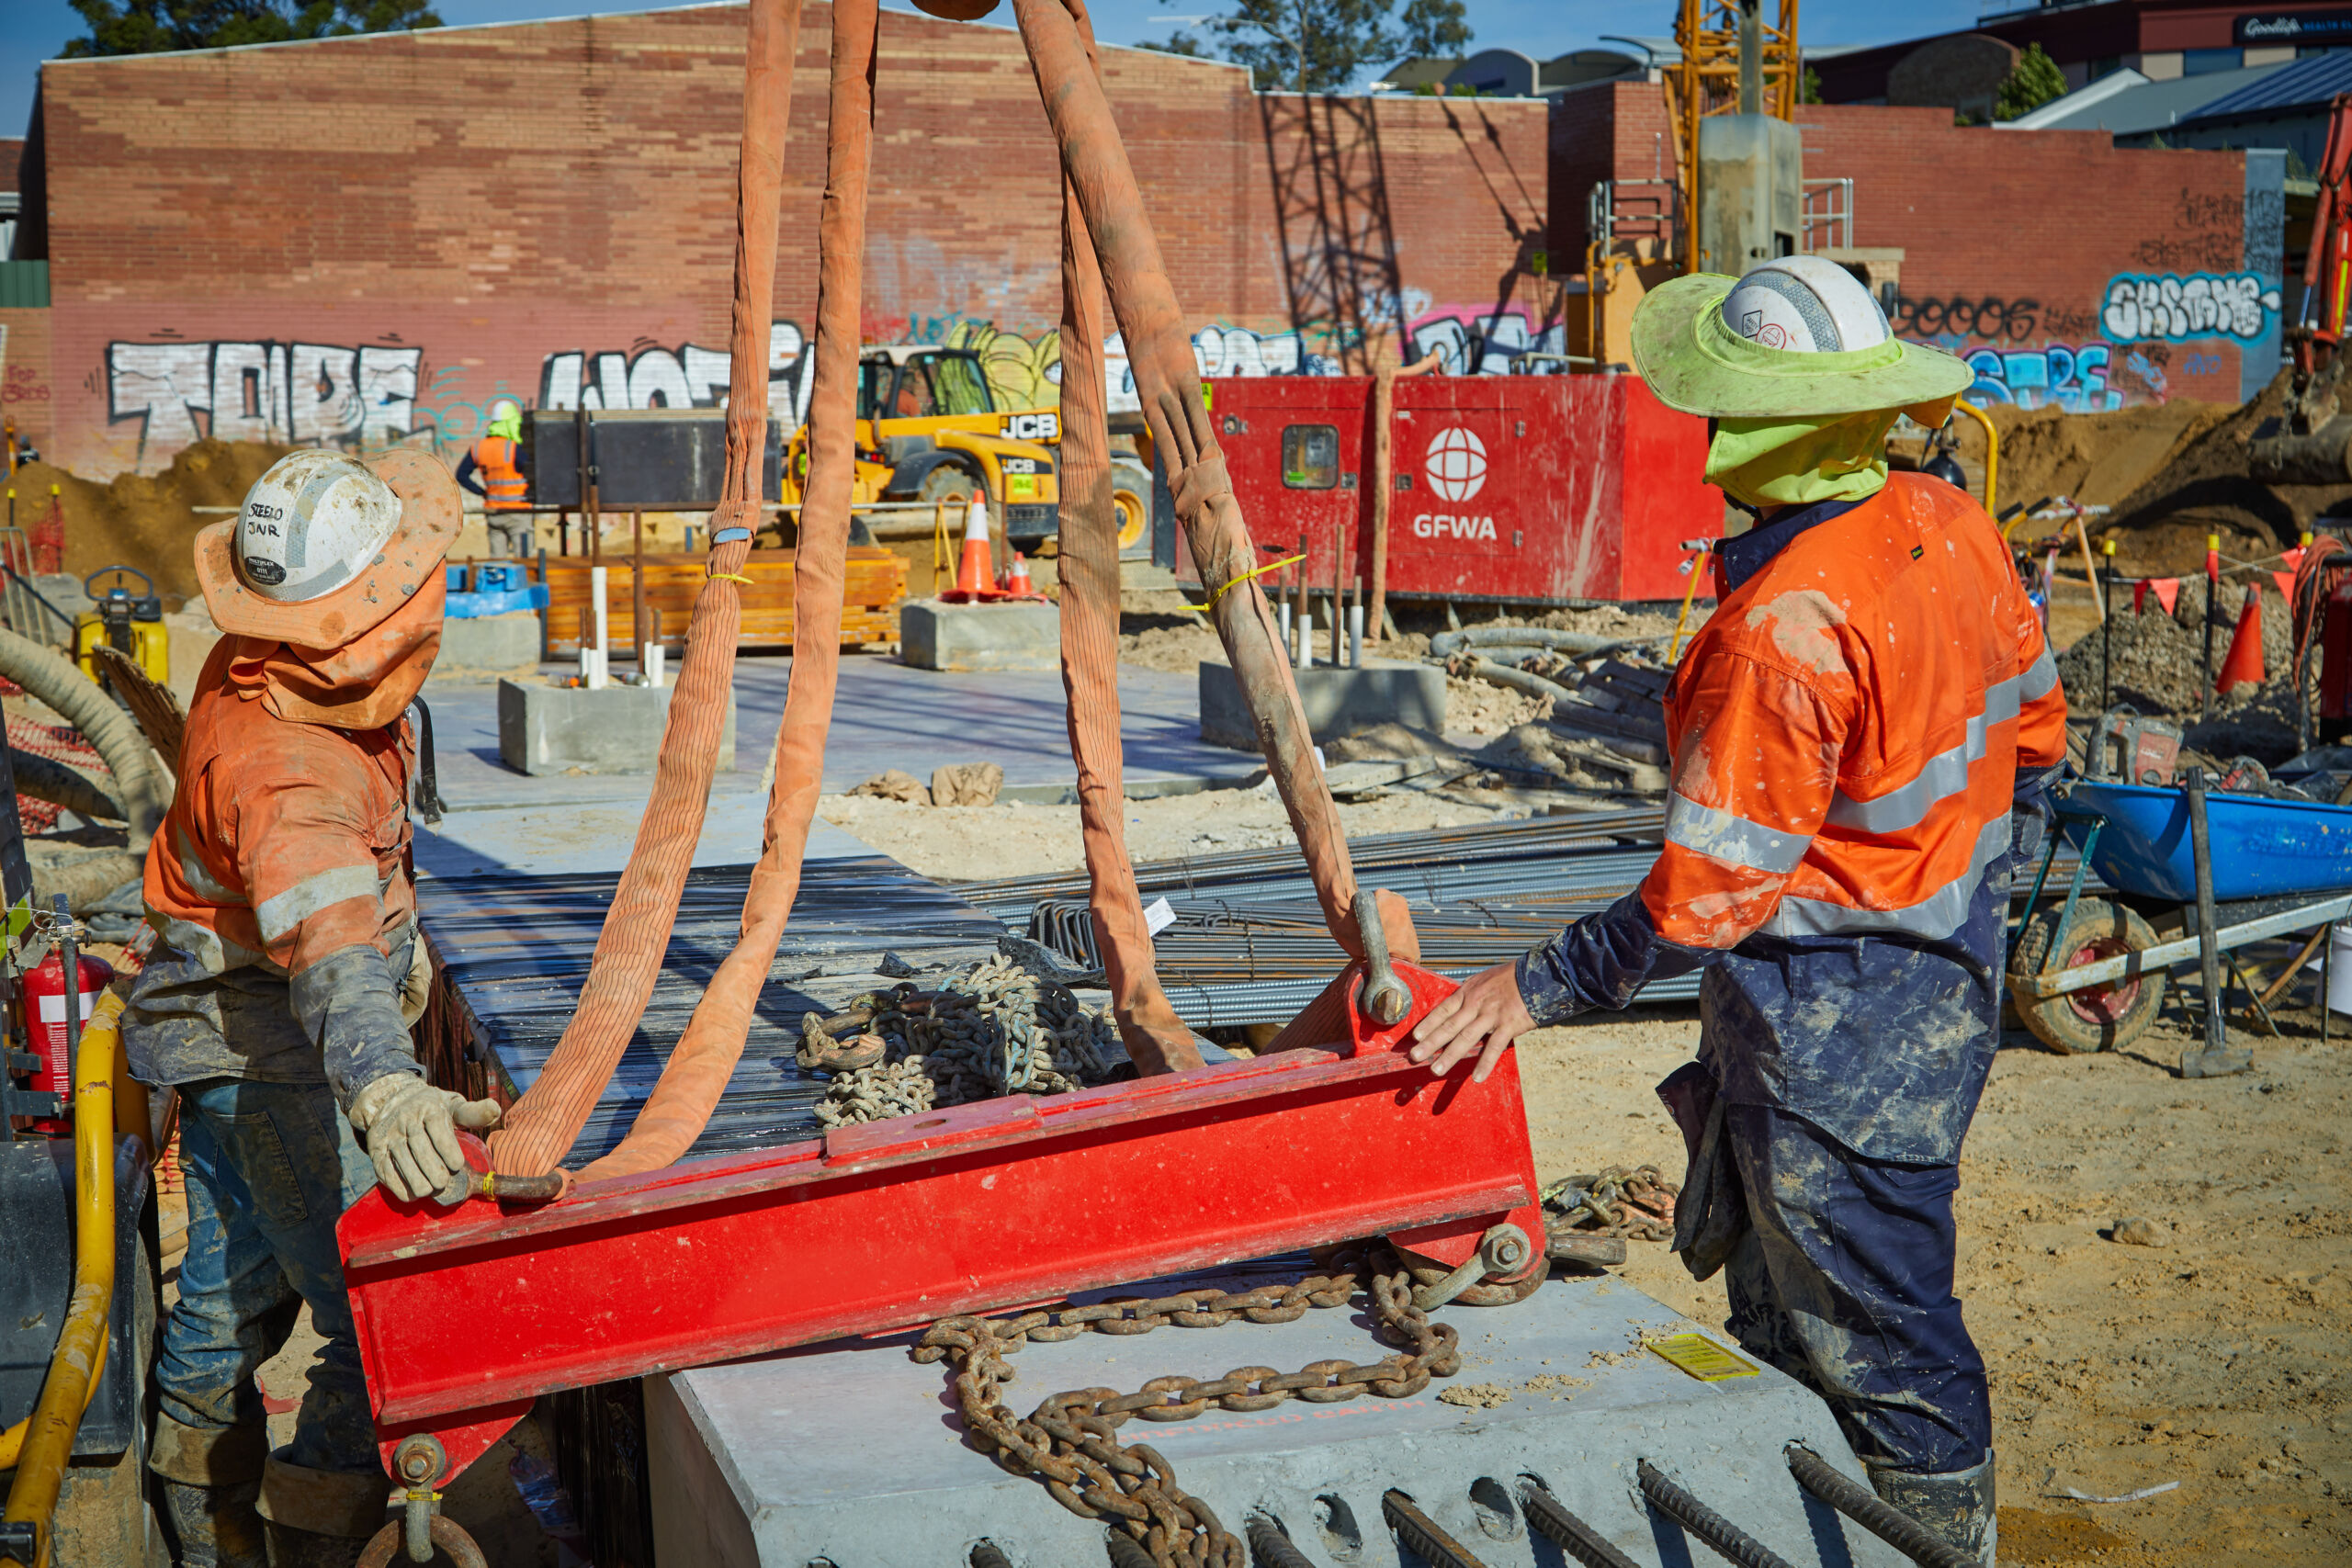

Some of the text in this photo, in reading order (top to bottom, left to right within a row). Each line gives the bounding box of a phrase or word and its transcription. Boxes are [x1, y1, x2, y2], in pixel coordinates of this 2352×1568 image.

[1000, 413, 1058, 440] JCB
[1001, 458, 1035, 474] JCB
[247, 521, 280, 537] JNR
[1414, 513, 1498, 540] GFWA
